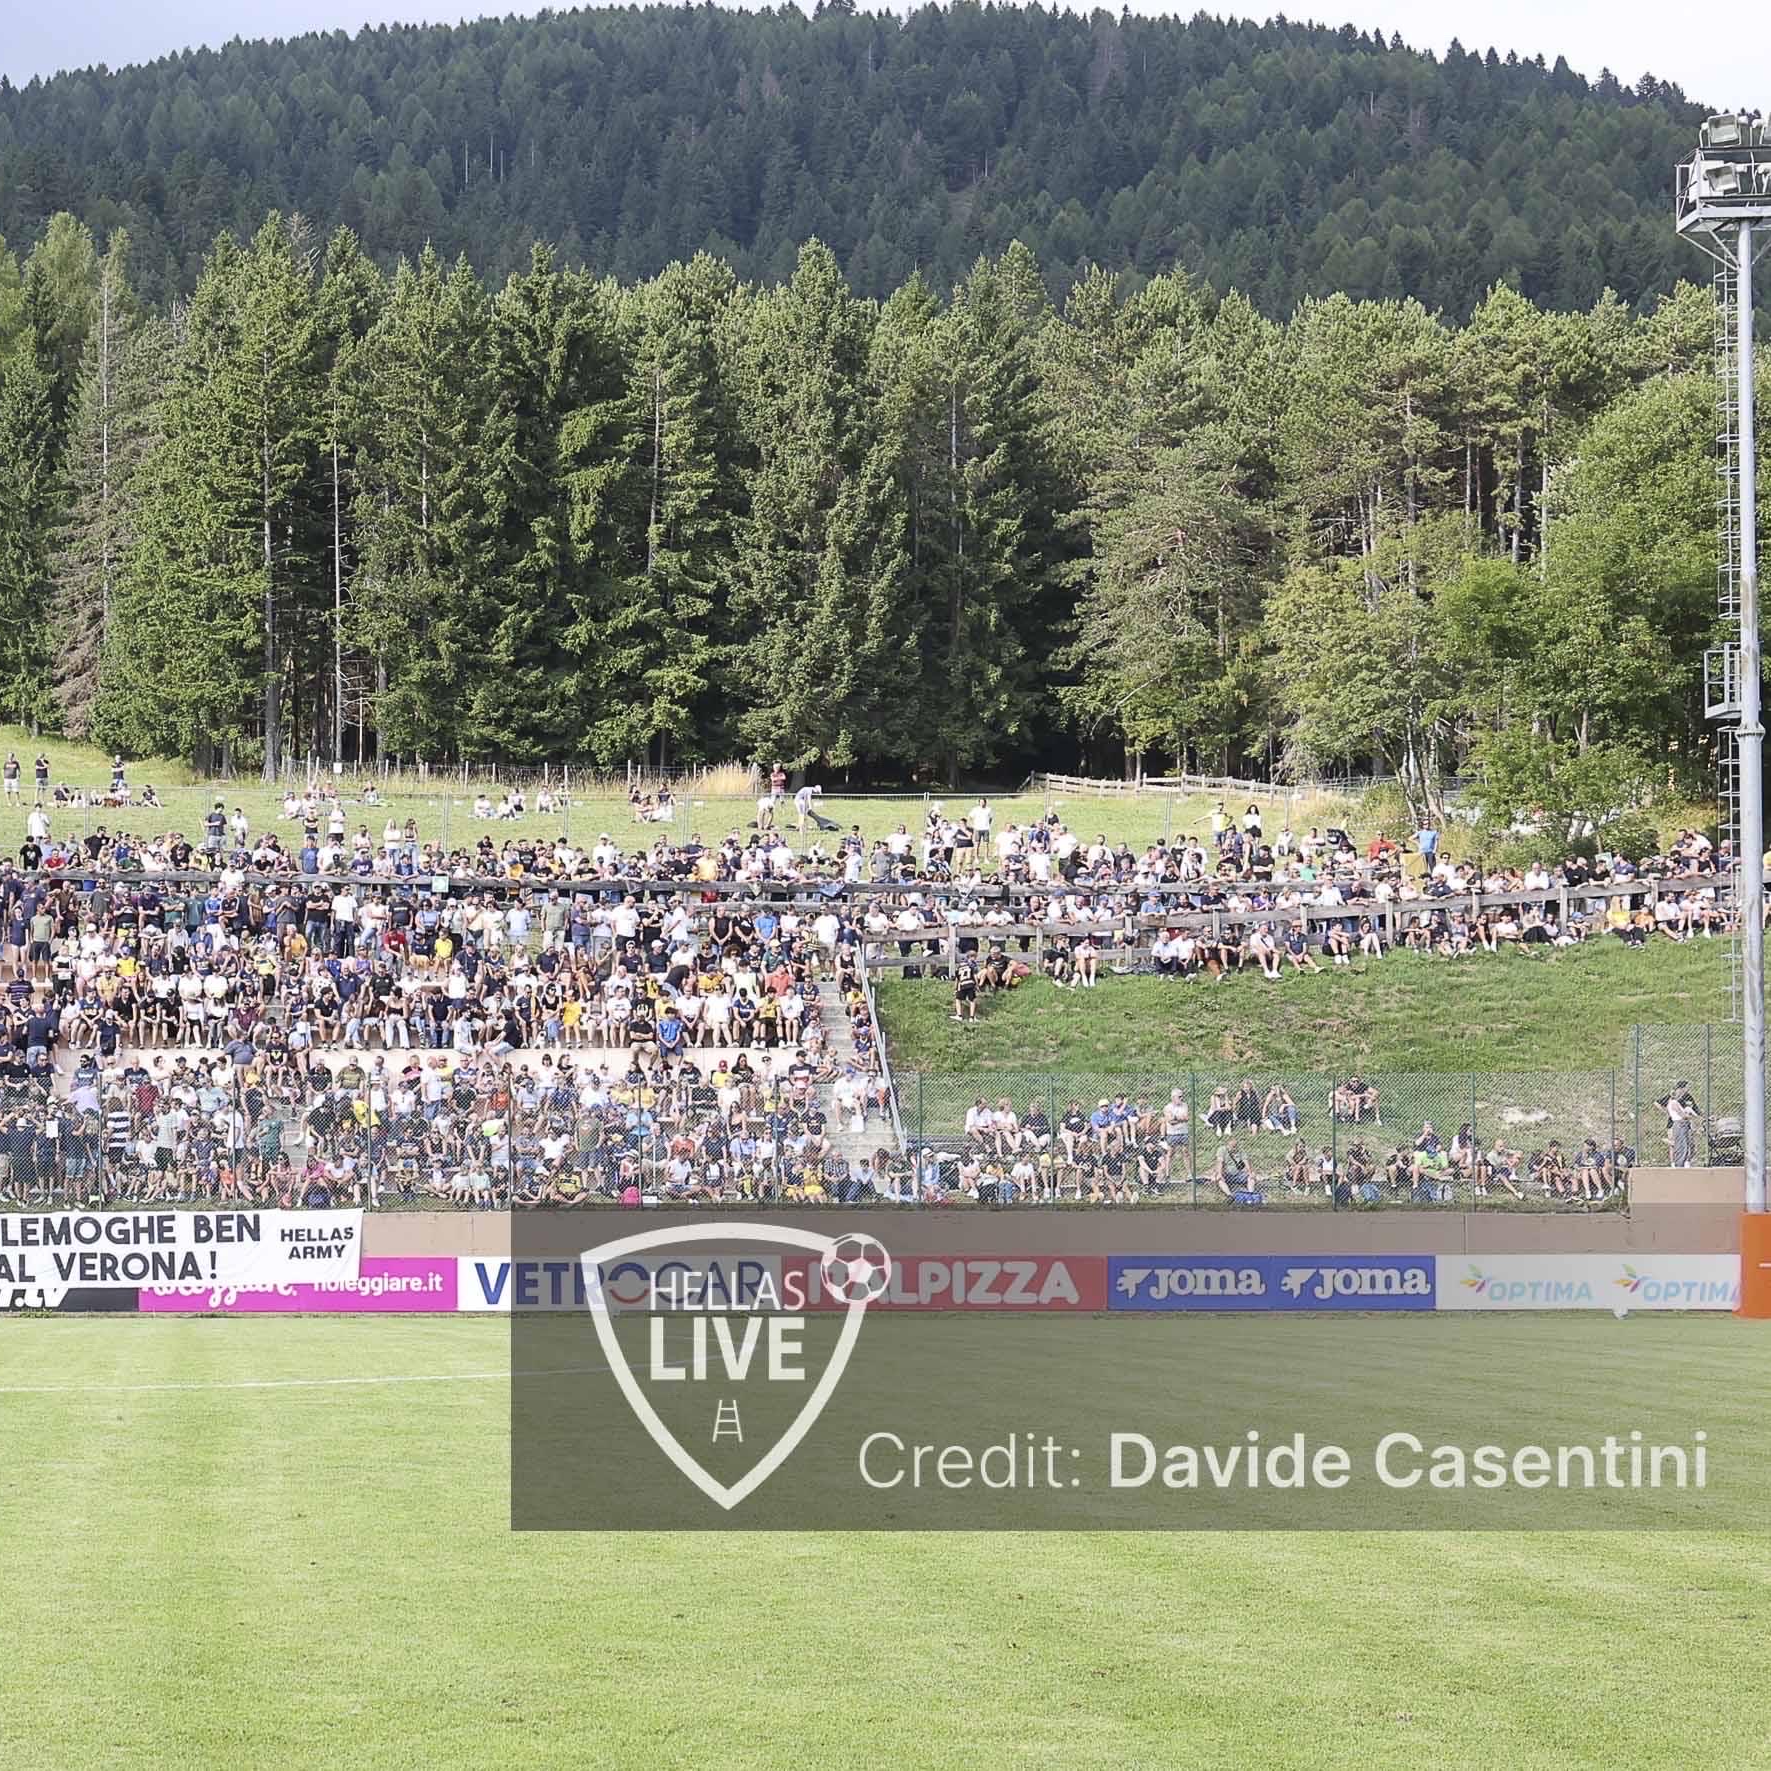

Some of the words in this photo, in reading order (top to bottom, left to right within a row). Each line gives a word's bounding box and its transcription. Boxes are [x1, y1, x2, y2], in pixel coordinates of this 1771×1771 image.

[194, 1213, 261, 1244] BEN
[280, 1226, 354, 1242] HELLAS
[288, 1244, 346, 1260] ARMY
[1488, 1280, 1594, 1302] OPTIMA
